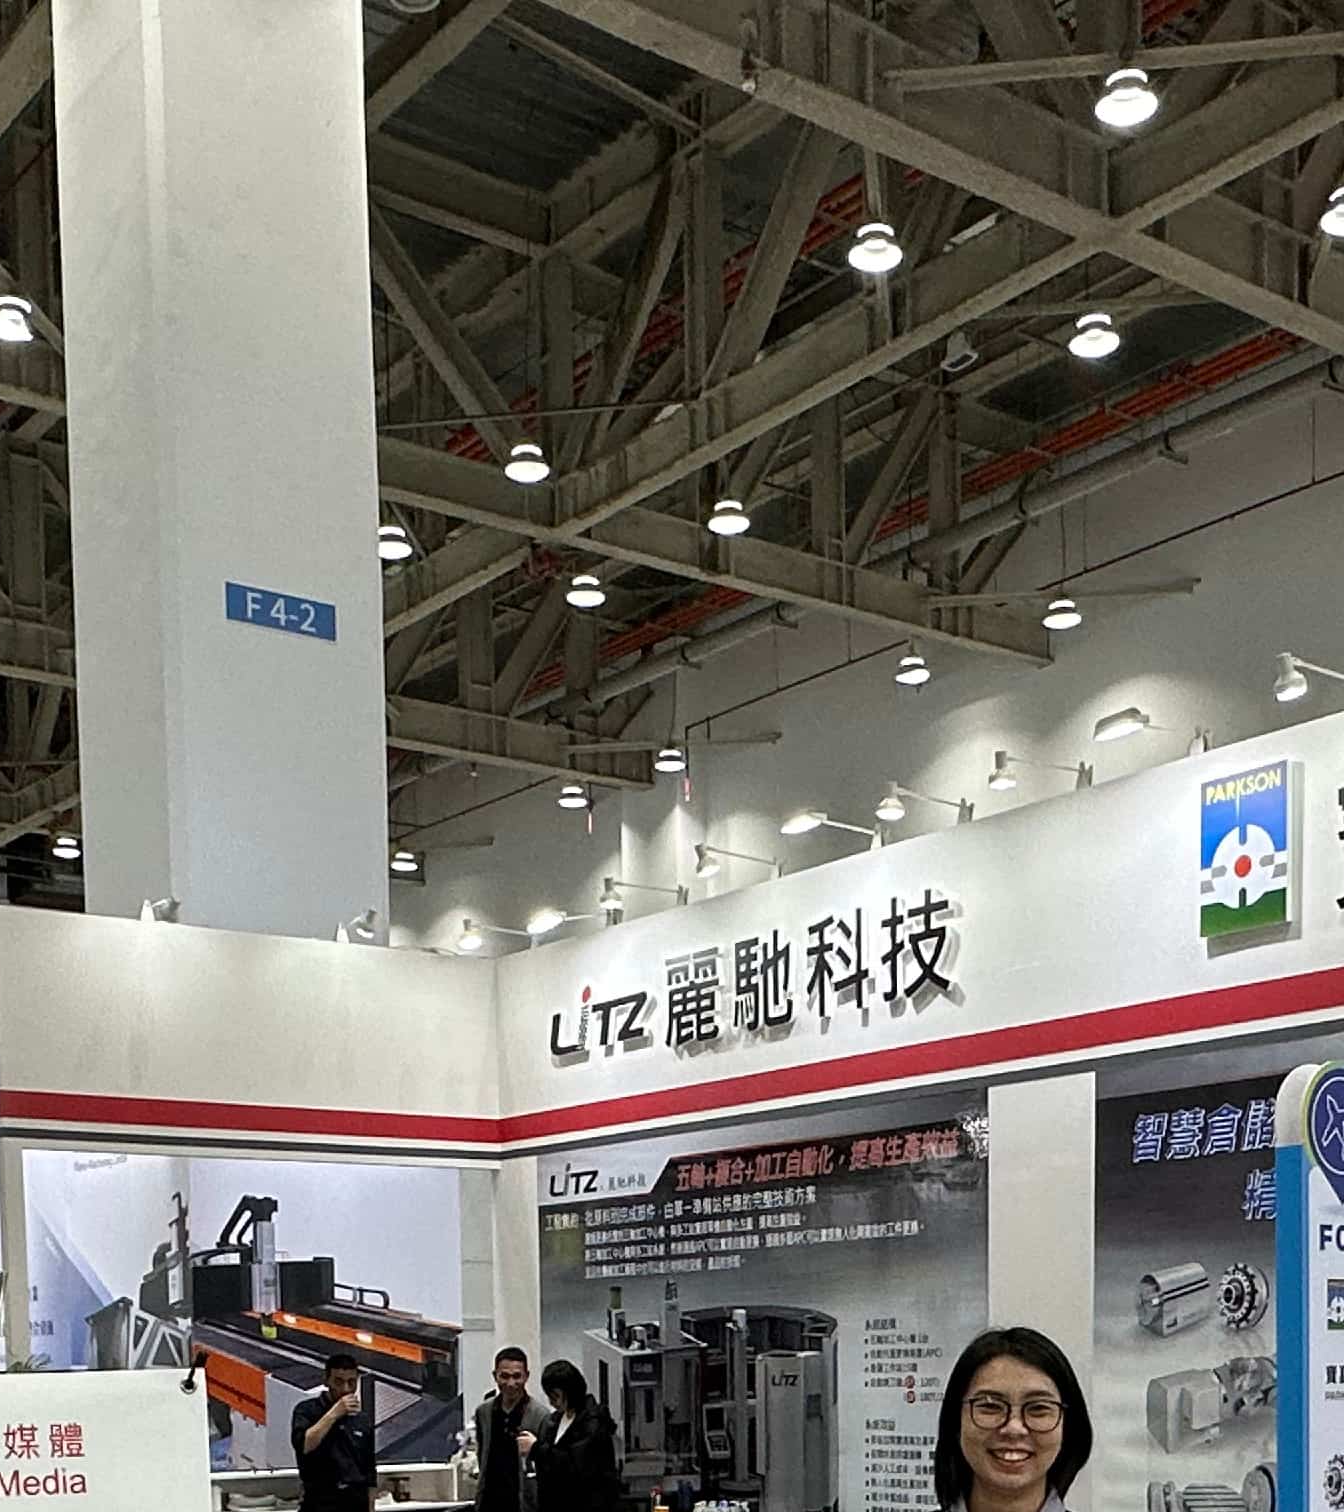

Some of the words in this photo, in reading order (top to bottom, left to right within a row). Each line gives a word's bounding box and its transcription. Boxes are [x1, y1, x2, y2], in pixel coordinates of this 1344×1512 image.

[1204, 767, 1282, 807] PARKSON
[665, 888, 952, 1048] 麗馳科技
